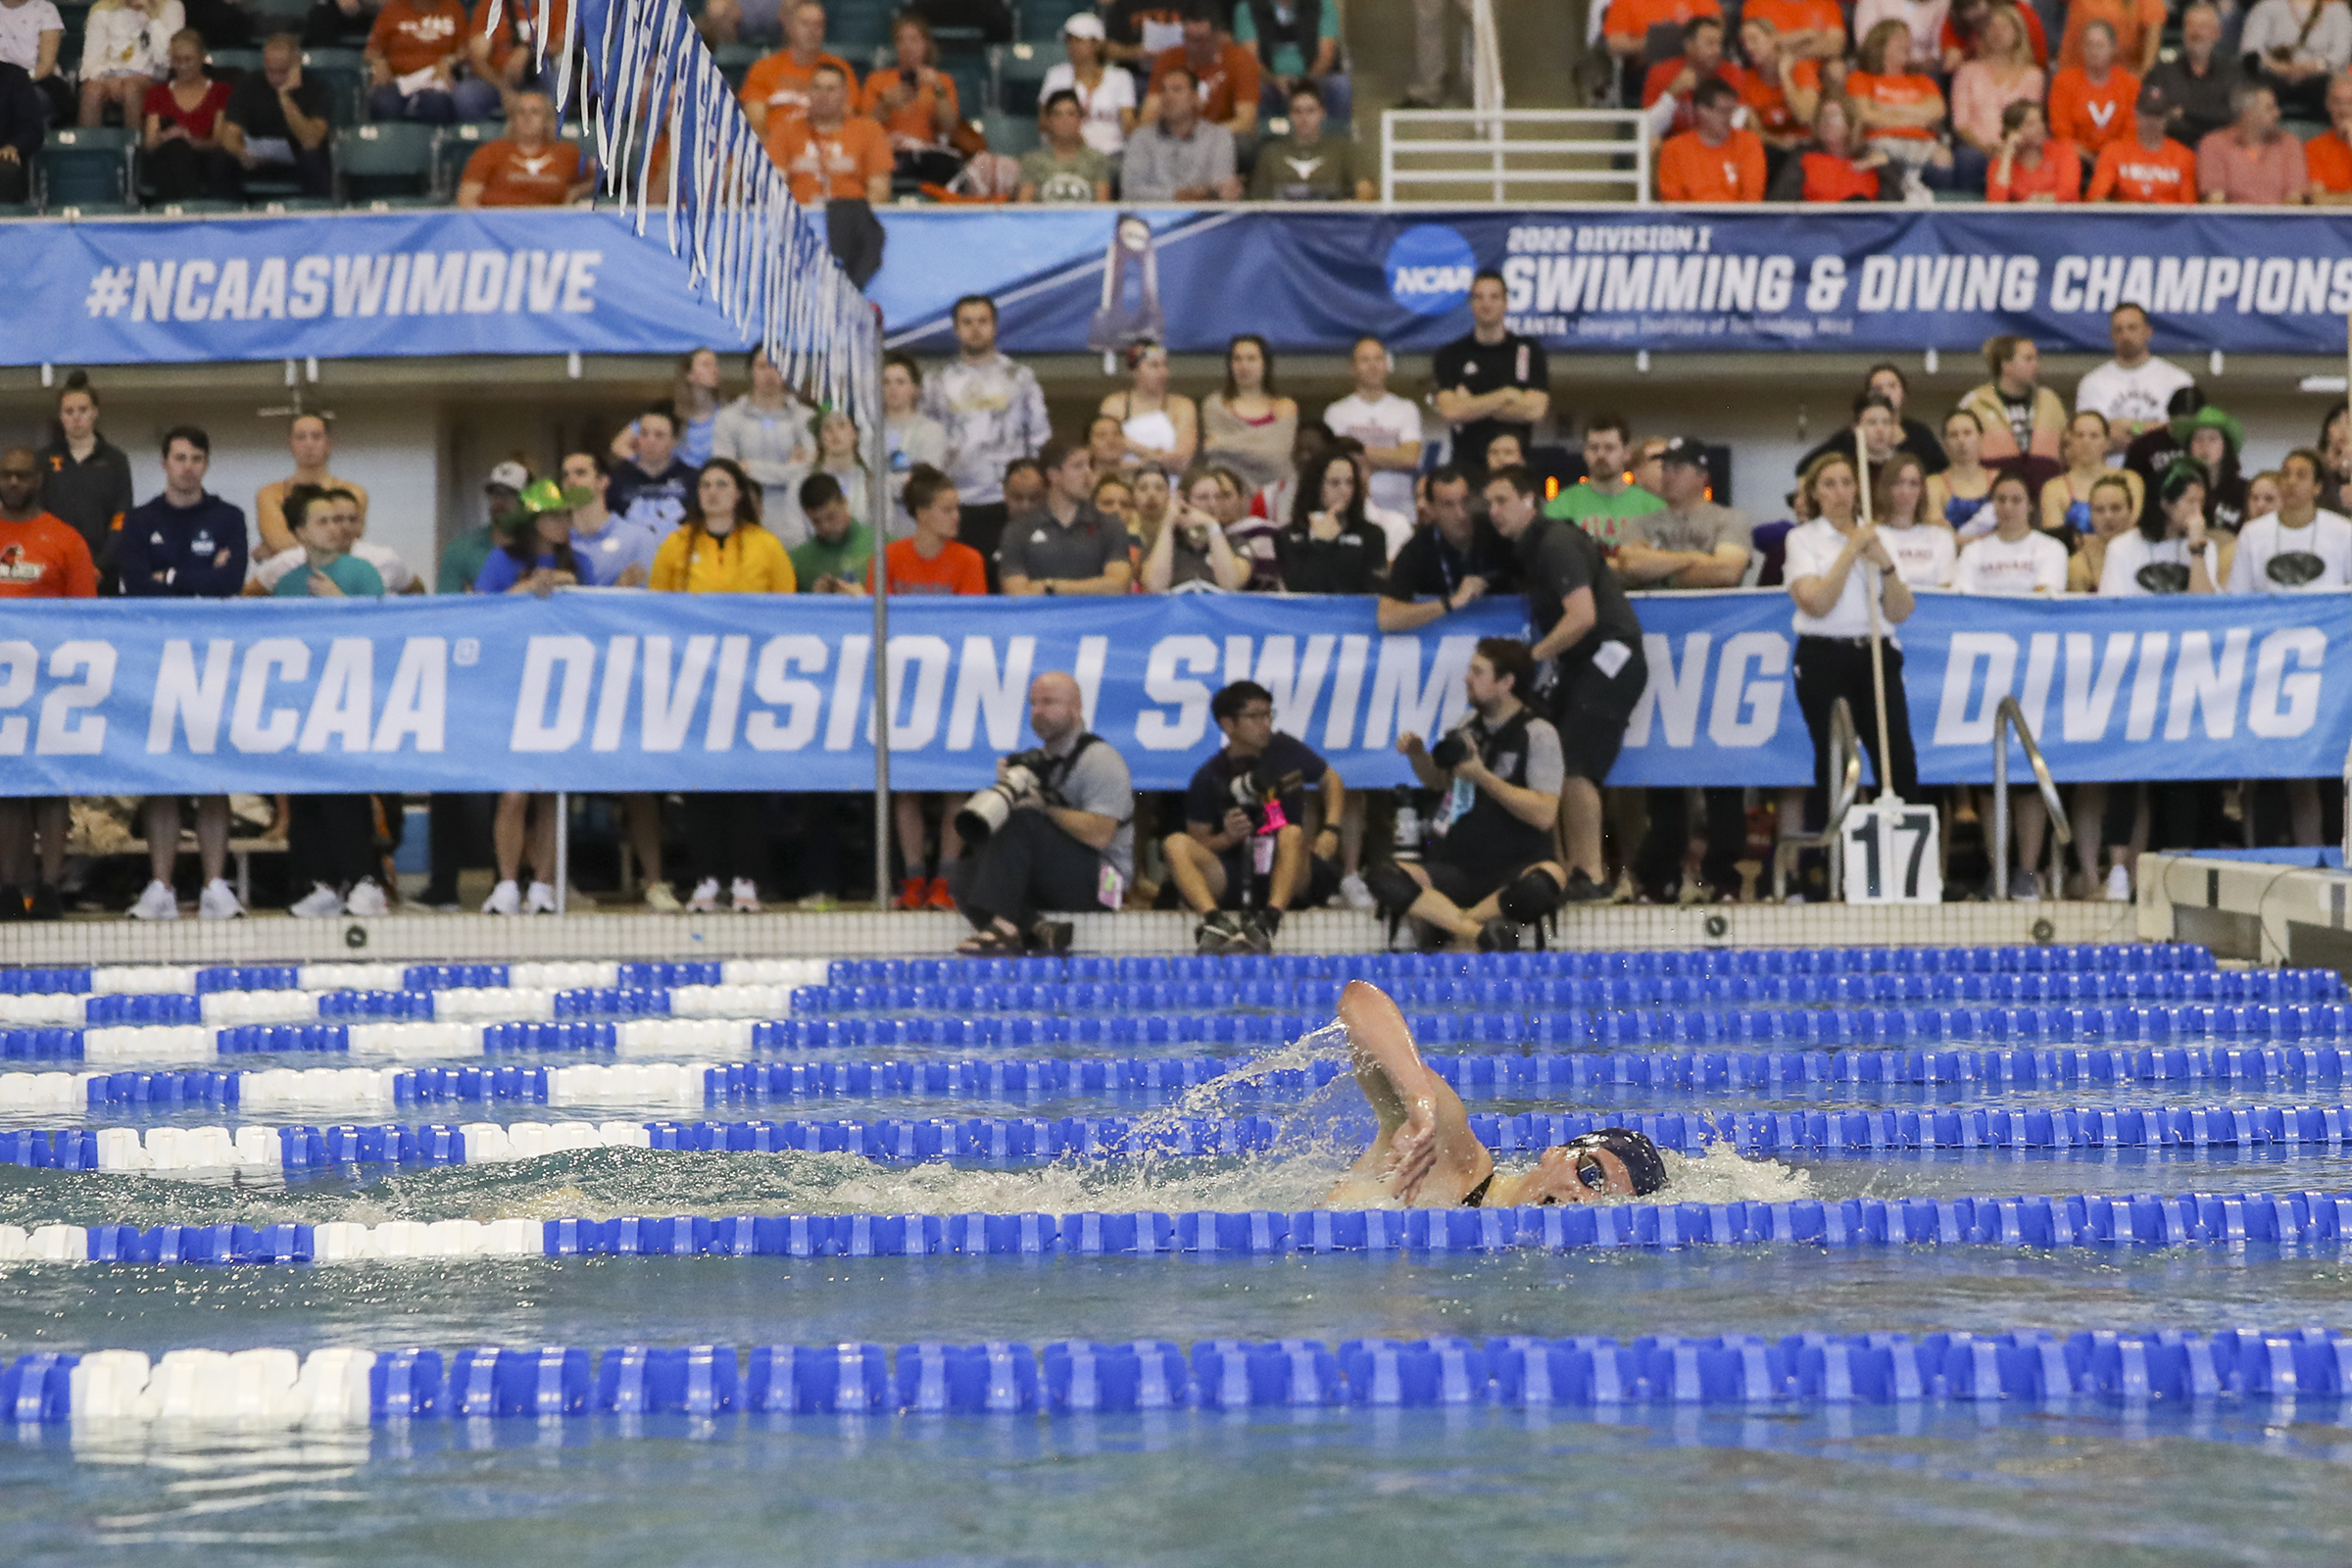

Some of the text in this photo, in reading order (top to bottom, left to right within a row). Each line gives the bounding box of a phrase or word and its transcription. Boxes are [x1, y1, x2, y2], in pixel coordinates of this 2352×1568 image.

[1507, 225, 1713, 253] 2022 DIVISION I
[84, 249, 603, 322] #NCAASWIMDIVE
[1392, 265, 1474, 294] NCAA
[1502, 254, 1796, 313] SWIMMING
[1806, 254, 1848, 313] &
[1857, 254, 2040, 313] DIVING
[508, 634, 1037, 754] DIVISION
[1133, 632, 1790, 751] SWIMNG
[1932, 626, 2328, 746] DIVING
[1851, 812, 1932, 899] 17
